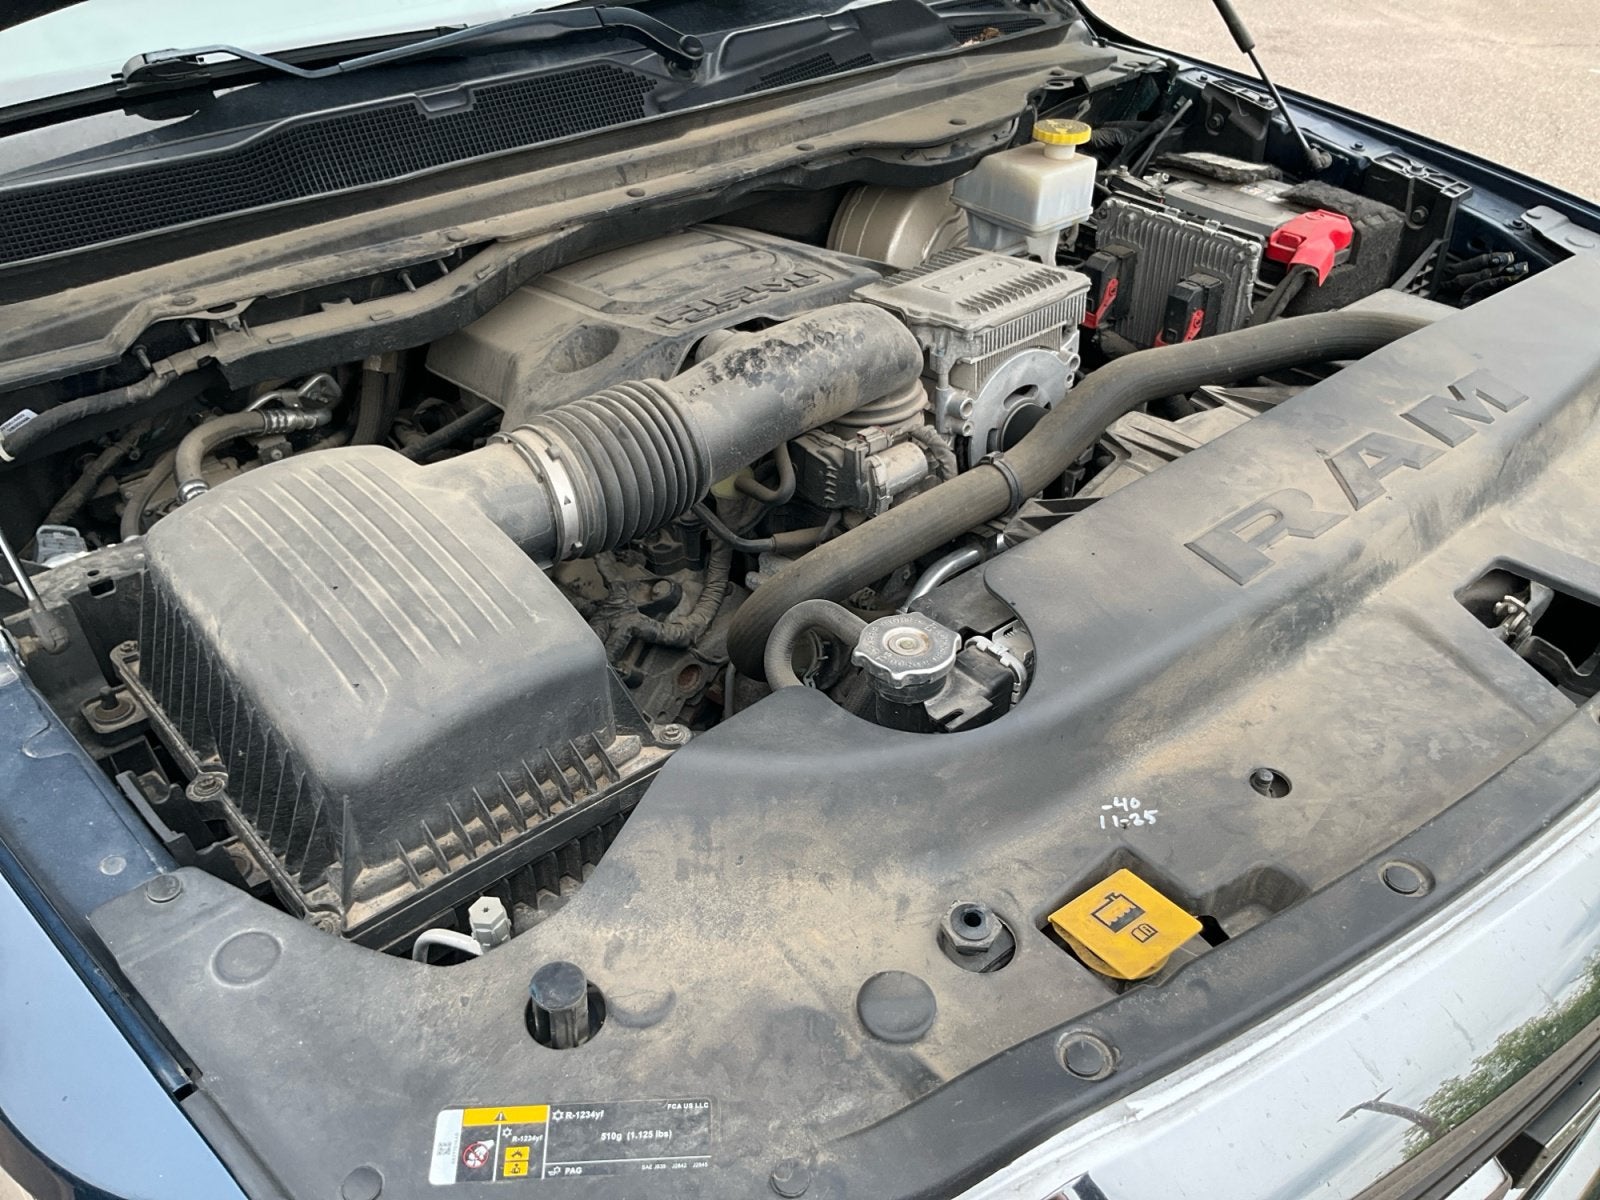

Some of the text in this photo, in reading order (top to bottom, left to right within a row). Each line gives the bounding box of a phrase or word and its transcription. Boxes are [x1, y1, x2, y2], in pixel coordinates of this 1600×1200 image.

[655, 269, 821, 323] HEMI
[1184, 368, 1530, 586] RAM
[1101, 796, 1141, 812] -40
[666, 1101, 709, 1111] FCA US LLC
[565, 1109, 605, 1121] R-1234yf
[511, 1134, 544, 1145] R-1234yf
[600, 1129, 673, 1142] 510g (1.125 lbs)
[564, 1166, 583, 1175] PAG
